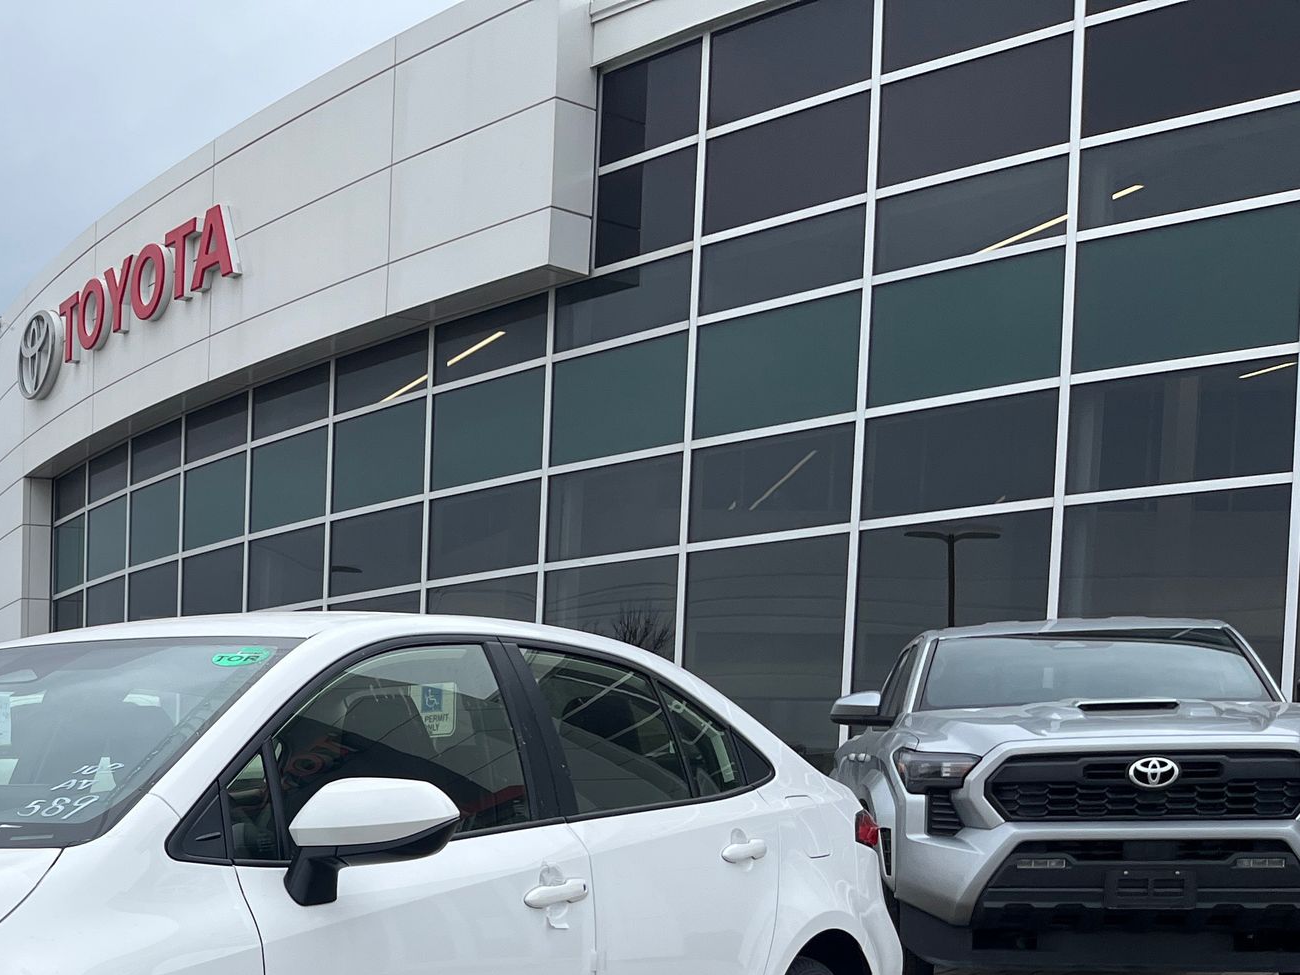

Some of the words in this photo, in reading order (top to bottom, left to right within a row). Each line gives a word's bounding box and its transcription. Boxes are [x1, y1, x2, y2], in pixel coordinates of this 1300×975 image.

[59, 204, 238, 363] TOYOTA
[424, 713, 450, 722] PERMIT
[16, 794, 100, 820] 589
